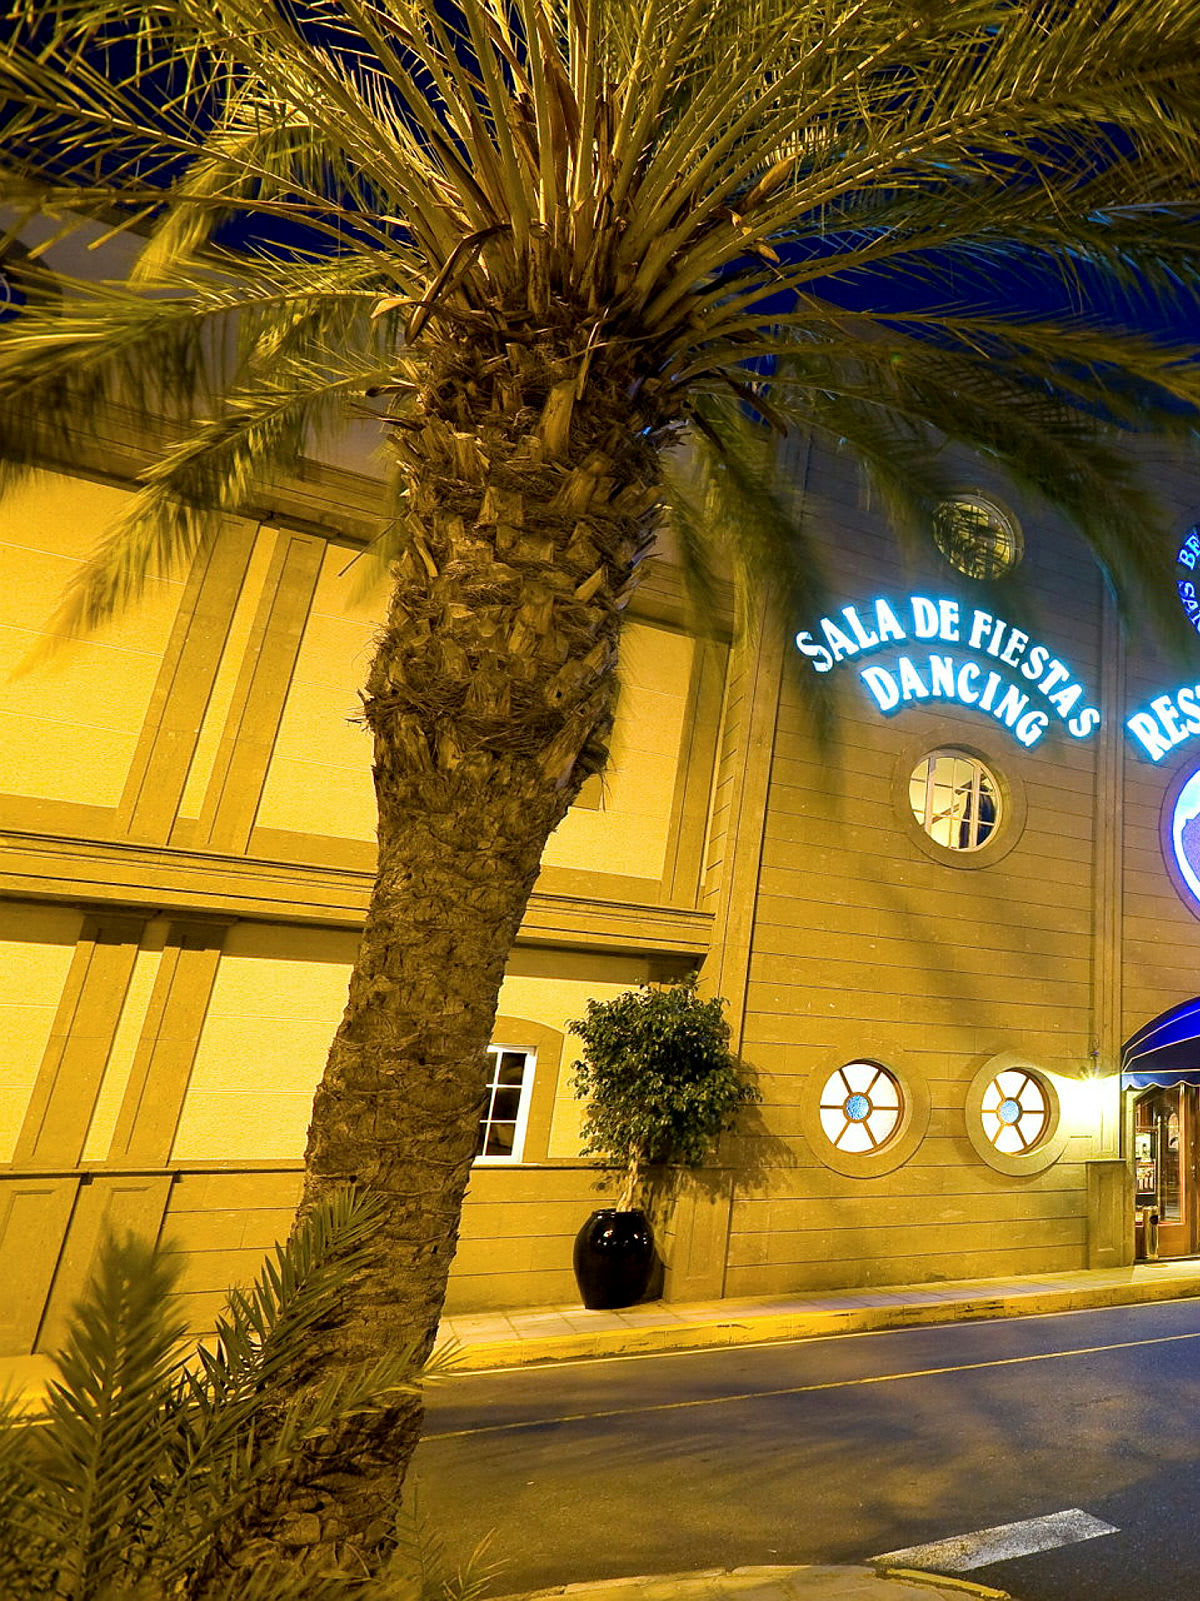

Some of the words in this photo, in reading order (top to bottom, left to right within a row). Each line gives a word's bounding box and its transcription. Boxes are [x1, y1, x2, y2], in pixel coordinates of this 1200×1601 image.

[795, 598, 906, 673] SALA
[910, 596, 960, 642] DE
[968, 609, 1101, 738] FIESTAS
[860, 655, 1049, 748] DANCING
